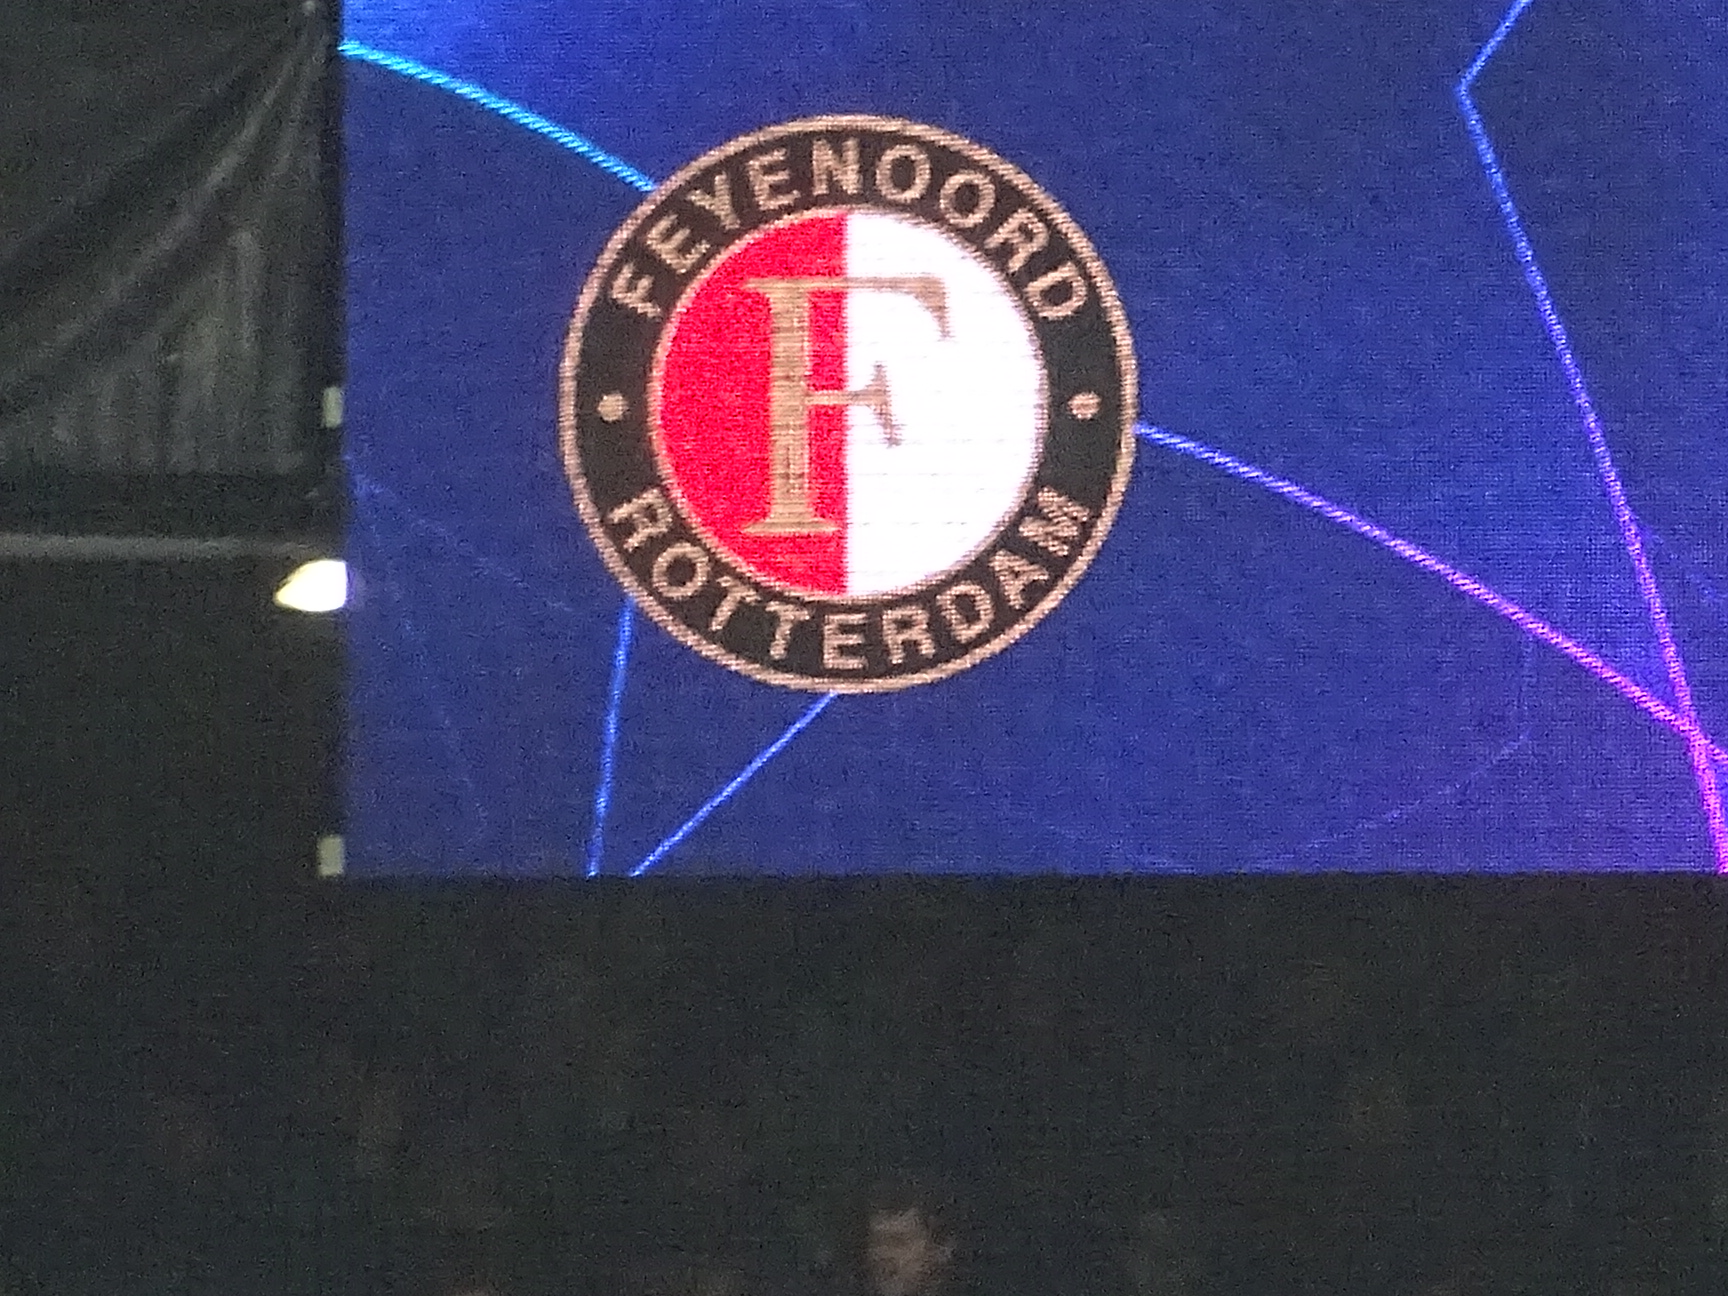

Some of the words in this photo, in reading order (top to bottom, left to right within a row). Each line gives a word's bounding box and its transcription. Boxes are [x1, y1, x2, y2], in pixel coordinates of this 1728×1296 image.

[610, 137, 1090, 322] FEYENOORD
[741, 274, 954, 536] F
[608, 484, 1093, 671] ROTTERDAM
